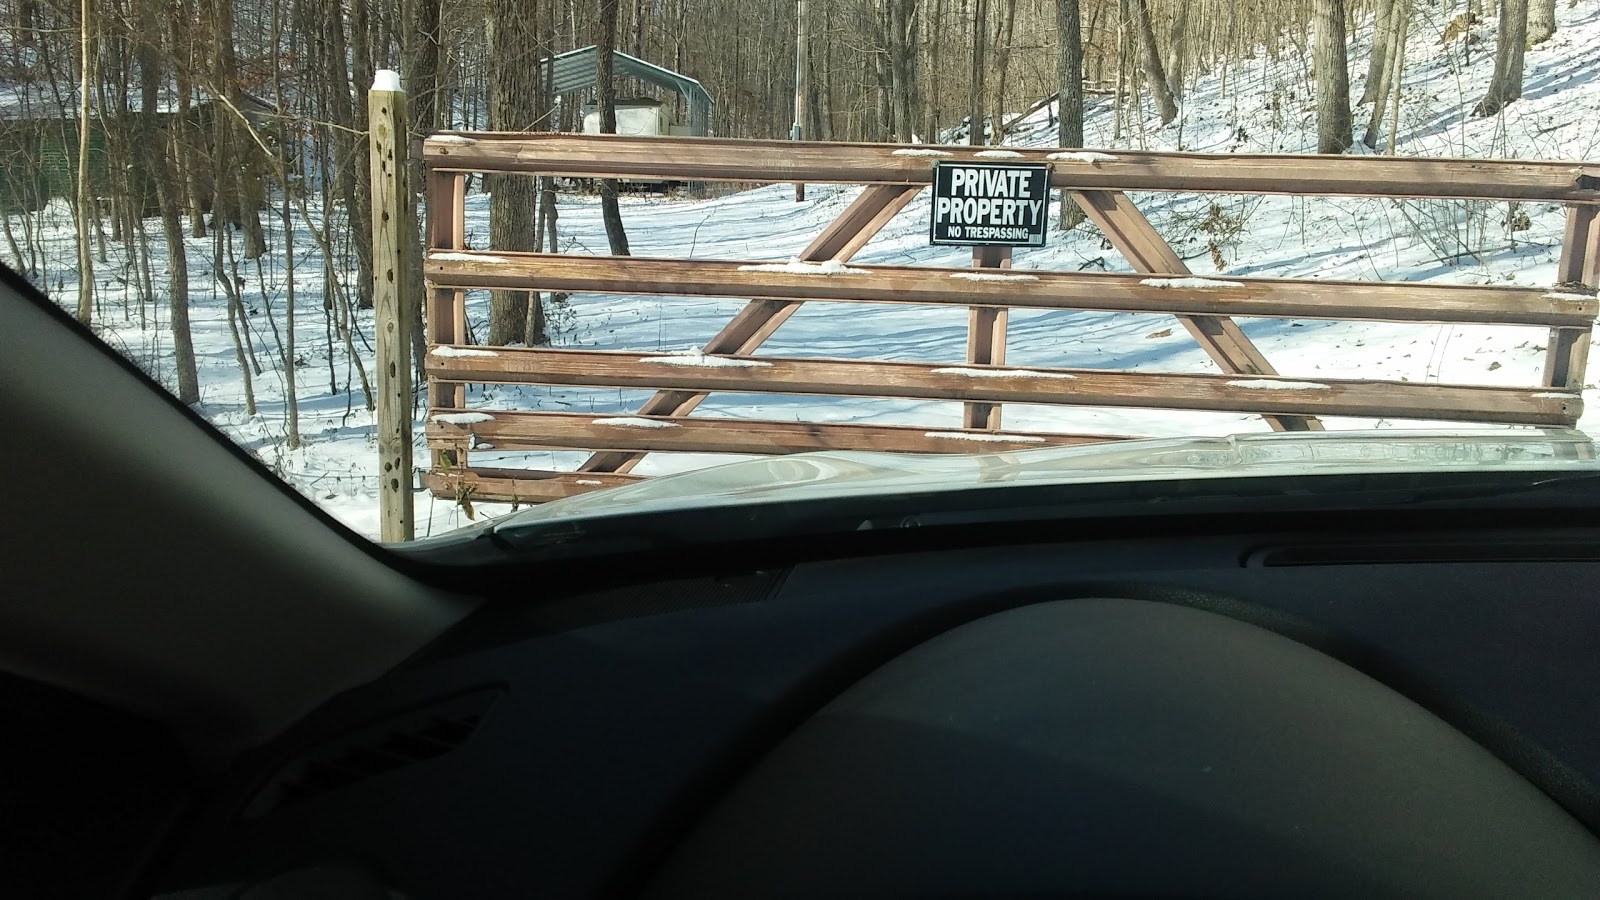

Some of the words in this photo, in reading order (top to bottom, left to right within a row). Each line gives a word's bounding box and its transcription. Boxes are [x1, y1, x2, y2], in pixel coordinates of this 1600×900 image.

[951, 168, 1032, 198] PRIVATE
[937, 197, 1042, 226] PROPERTY
[947, 226, 962, 238] NO
[964, 226, 1029, 239] TRESPASSING
